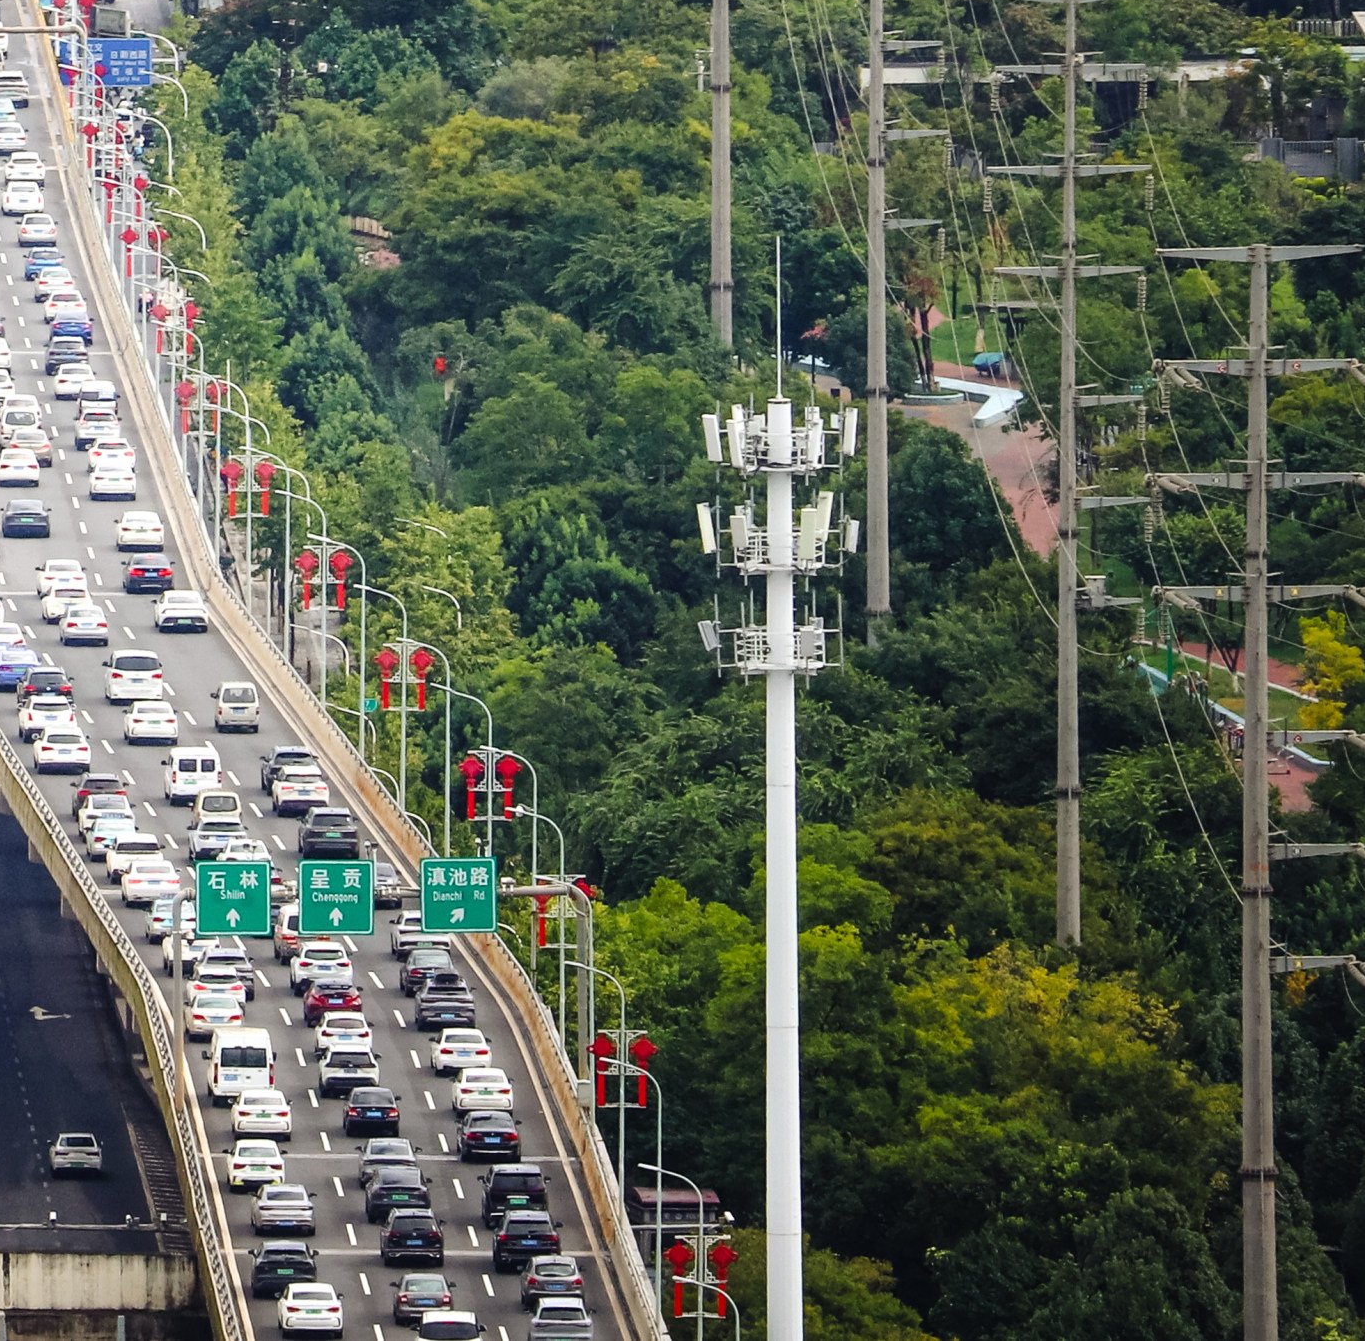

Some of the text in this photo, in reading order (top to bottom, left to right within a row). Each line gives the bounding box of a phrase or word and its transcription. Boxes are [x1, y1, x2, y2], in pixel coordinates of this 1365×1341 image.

[207, 870, 259, 890] 石林
[310, 869, 362, 889] 呈贡
[427, 867, 489, 887] 滇池路
[220, 890, 245, 900] Shilin
[312, 891, 359, 904] Chenggong
[433, 890, 485, 901] Dianchi Rd
